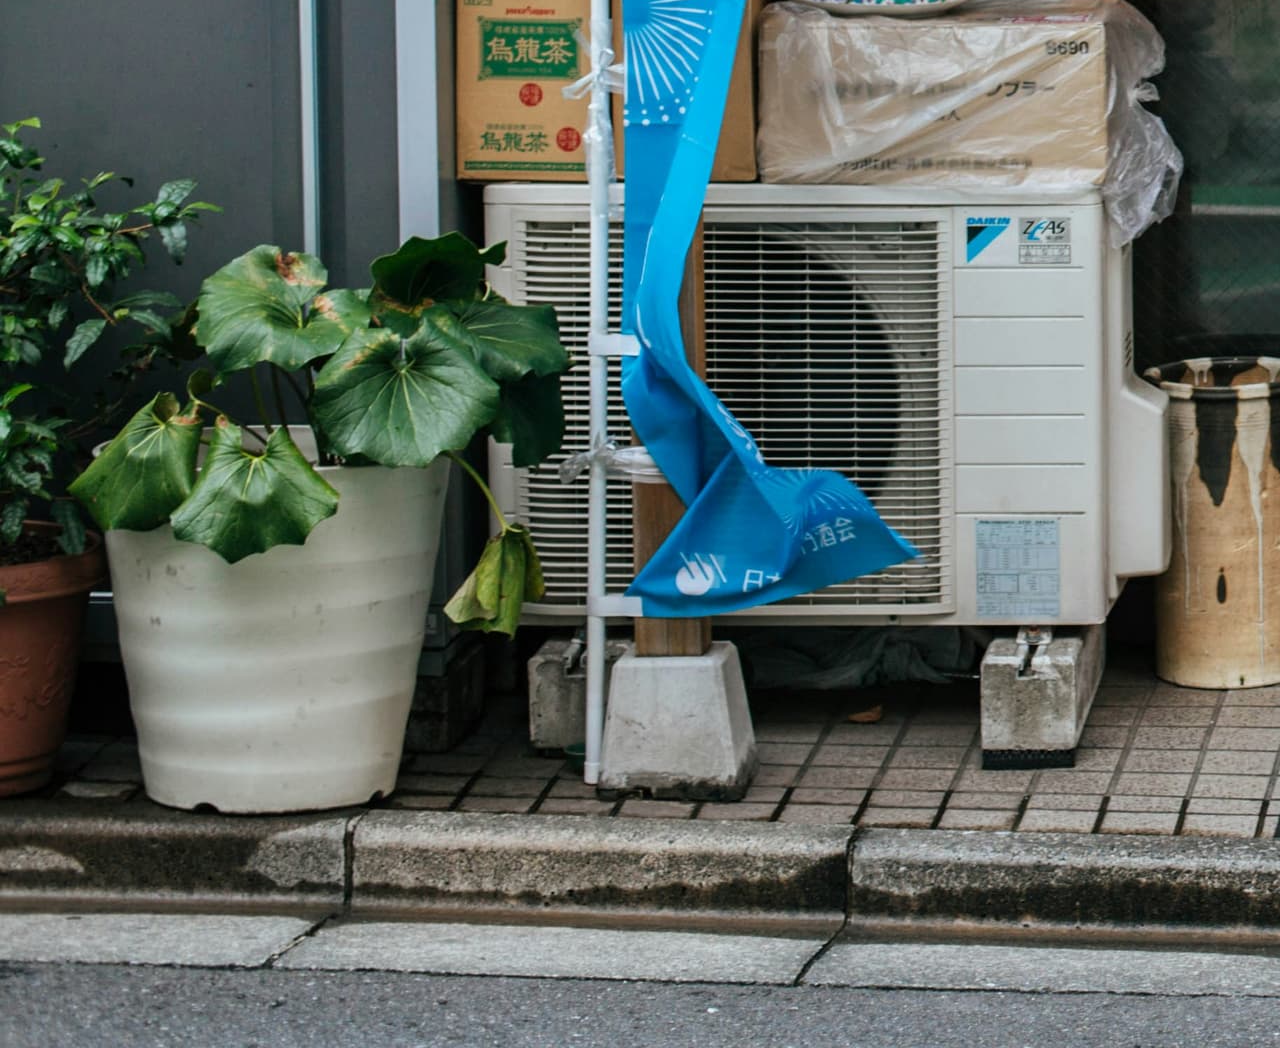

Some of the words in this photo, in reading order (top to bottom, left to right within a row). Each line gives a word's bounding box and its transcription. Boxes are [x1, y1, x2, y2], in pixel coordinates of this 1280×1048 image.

[487, 36, 574, 65] 烏龍茶
[966, 216, 1011, 225] DAIKIN
[1022, 219, 1066, 241] ZEAS
